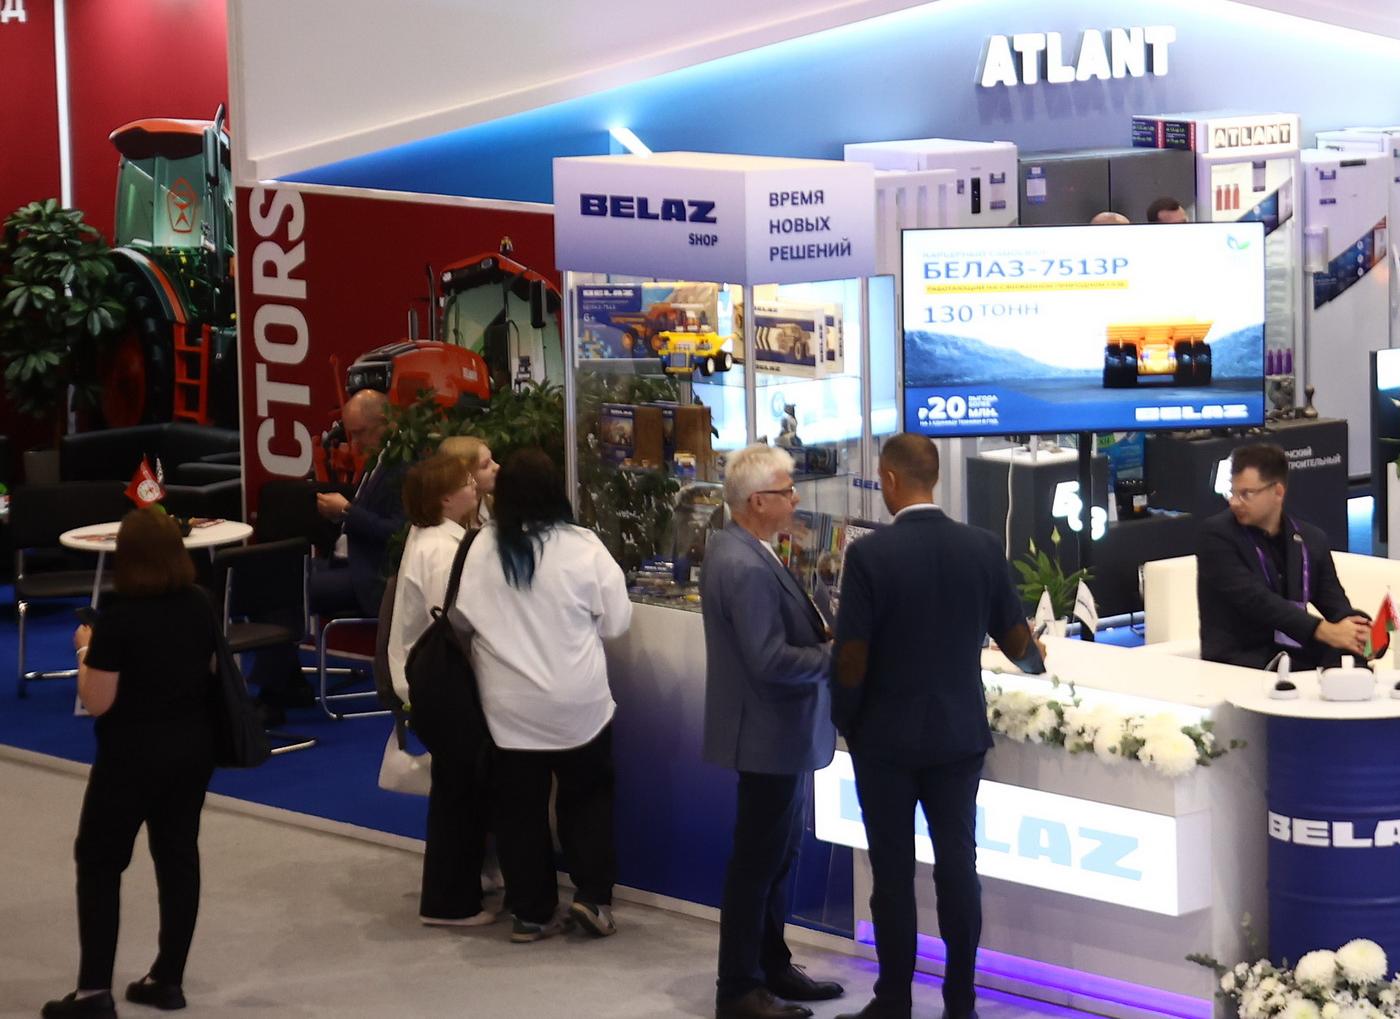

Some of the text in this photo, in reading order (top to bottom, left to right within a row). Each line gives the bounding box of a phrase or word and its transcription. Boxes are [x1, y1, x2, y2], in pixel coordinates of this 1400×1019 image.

[979, 25, 1177, 88] ATLANT
[1214, 123, 1292, 149] ATLANT
[580, 193, 718, 224] BELAZ
[769, 190, 825, 207] ВРЕМЯ
[769, 215, 831, 234] НОВЫХ
[688, 232, 719, 247] SHOP
[769, 236, 852, 262] РЕШЕНИЙ
[923, 257, 1129, 280] БЕЛАЗ-7513Р
[923, 303, 1039, 324] 130 ТОНН
[250, 186, 314, 478] CTORS
[1135, 404, 1249, 422] BELAZ
[839, 778, 1142, 881] BLAZ
